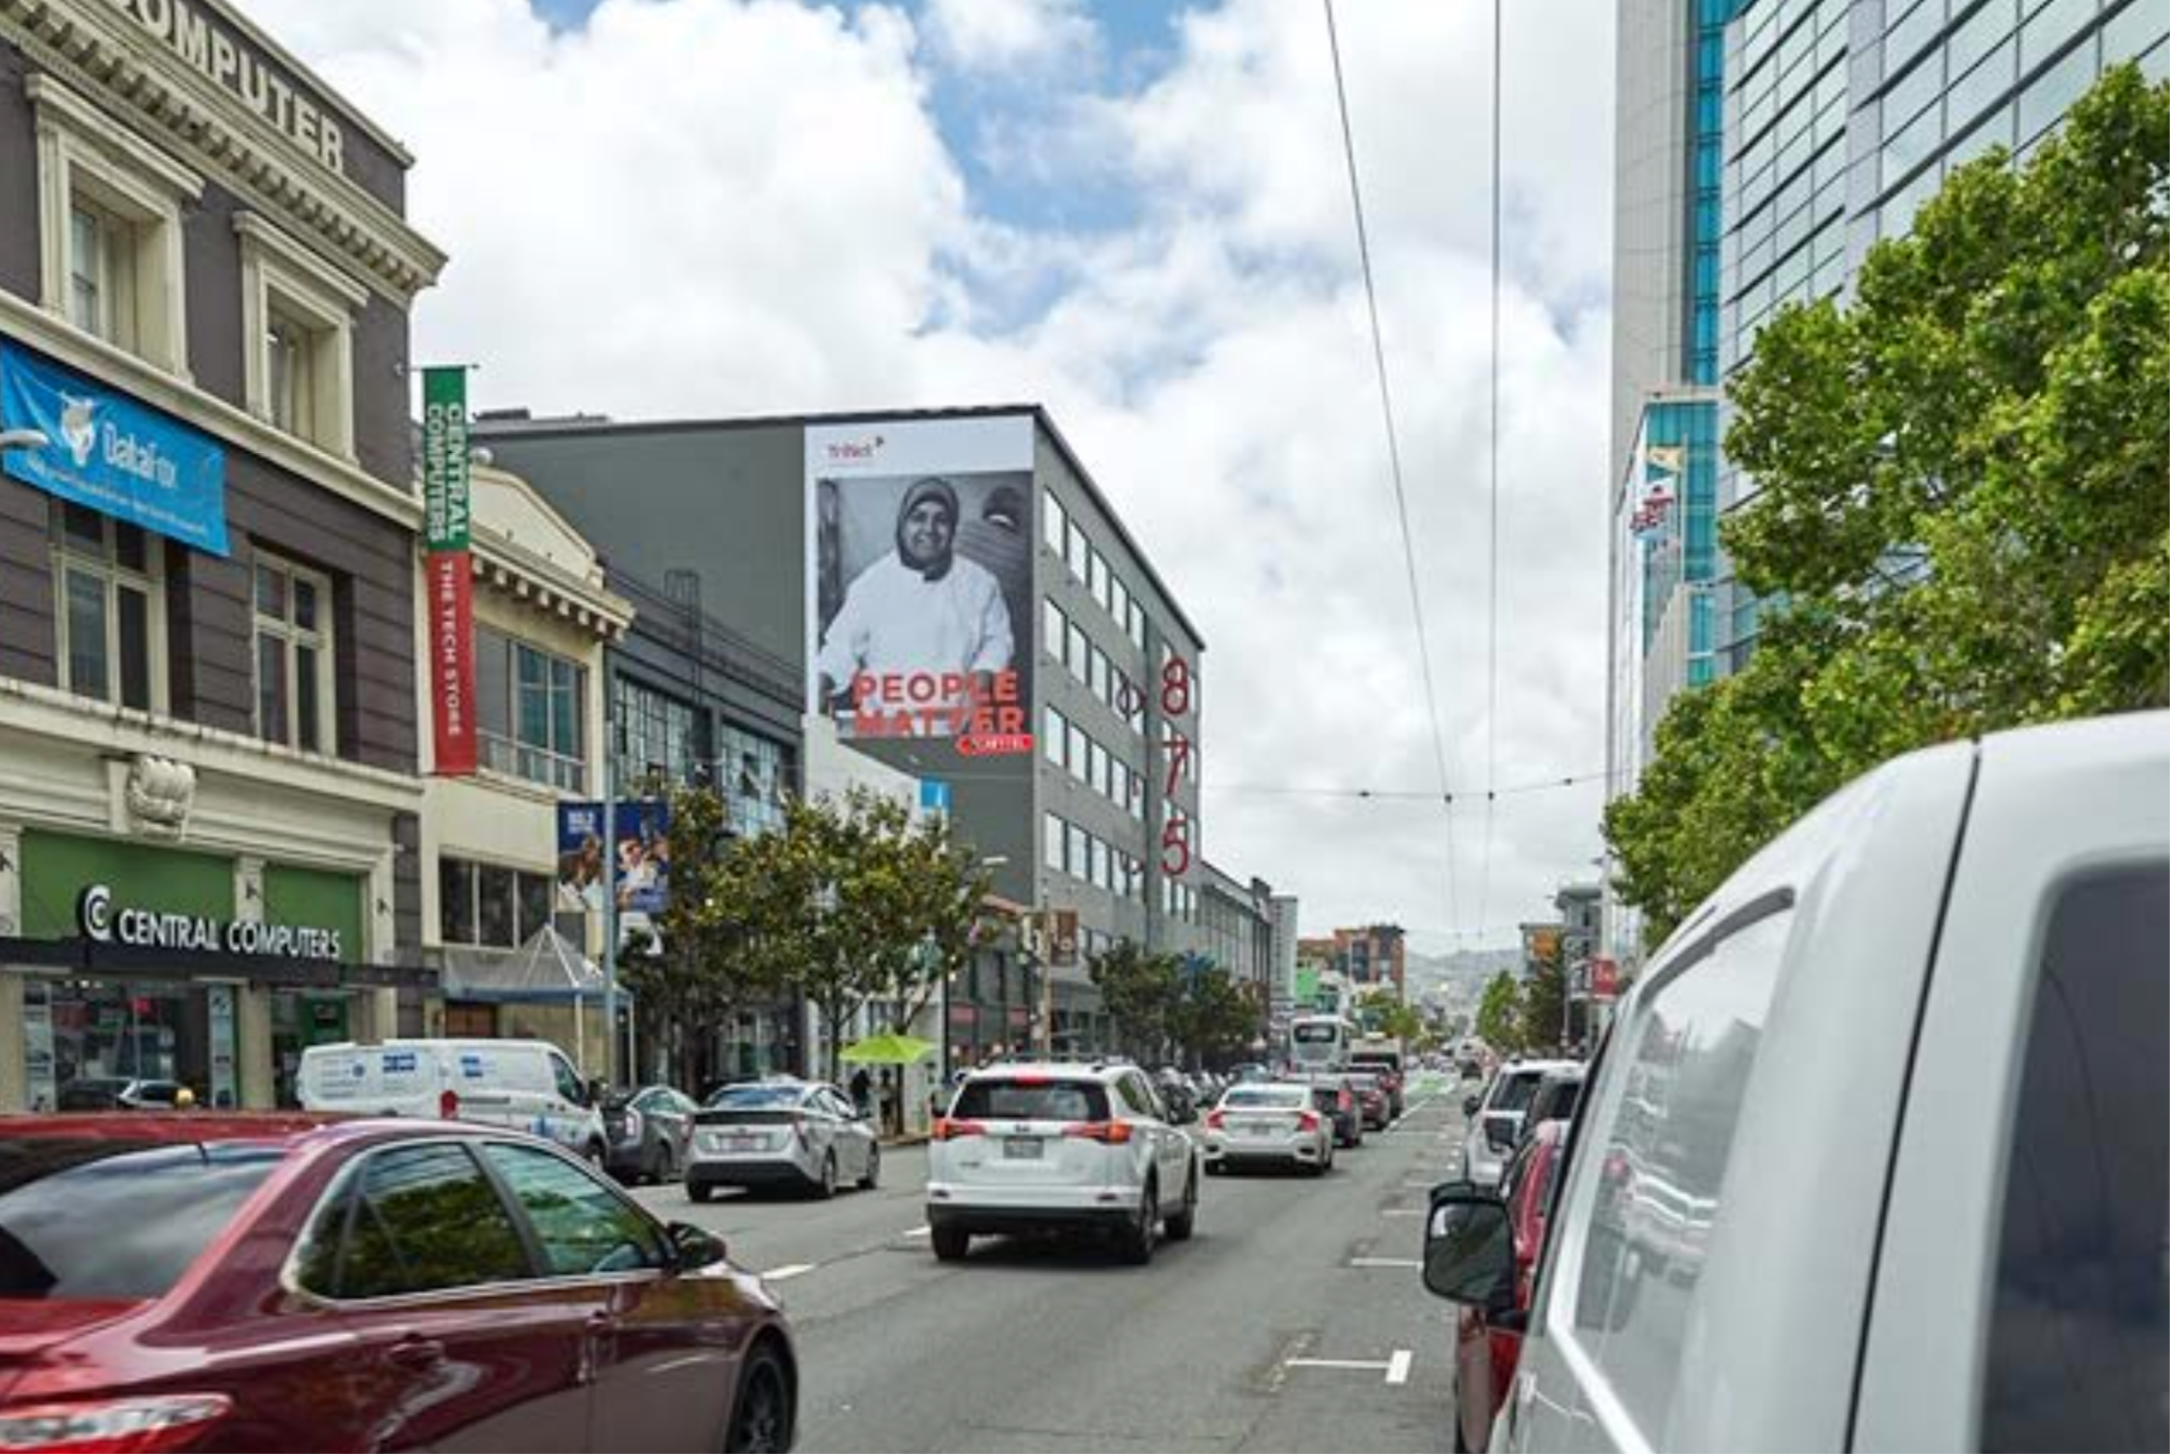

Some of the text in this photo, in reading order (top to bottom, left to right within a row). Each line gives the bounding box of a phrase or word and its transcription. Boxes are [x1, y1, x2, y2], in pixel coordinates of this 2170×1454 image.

[428, 403, 447, 542] COMPUTERS
[448, 402, 467, 541] CENTRAL
[441, 562, 461, 736] THE TECH STORE
[853, 670, 1018, 704] PEOPLE
[854, 705, 1024, 737] MATTER
[118, 909, 219, 950] CENTRAL
[227, 921, 340, 959] COMPUTERS
